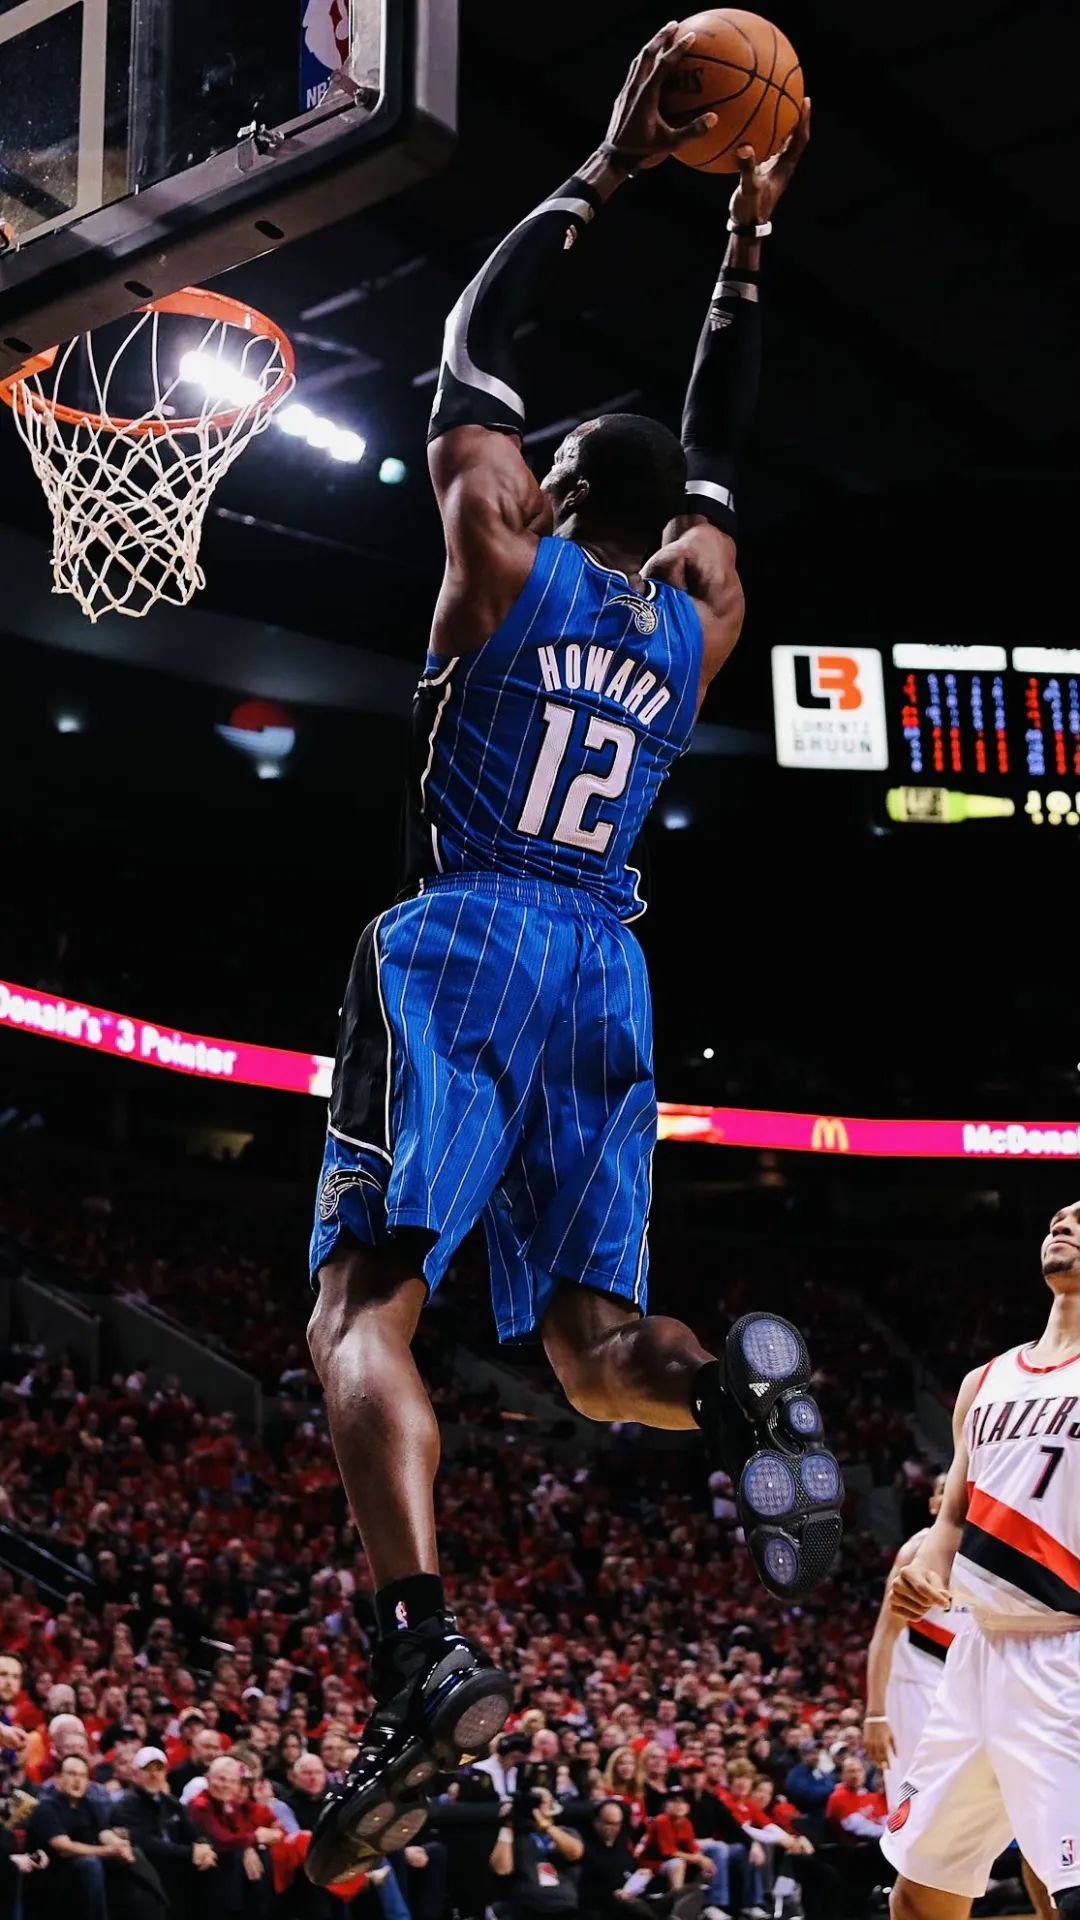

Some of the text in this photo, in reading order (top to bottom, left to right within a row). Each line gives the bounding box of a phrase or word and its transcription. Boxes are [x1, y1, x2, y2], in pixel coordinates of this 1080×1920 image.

[306, 80, 329, 109] NB
[537, 644, 671, 726] HOWARD
[516, 701, 637, 853] 12
[115, 1018, 136, 1053] 3
[140, 1025, 237, 1075] Pointer
[1030, 1446, 1065, 1500] 7
